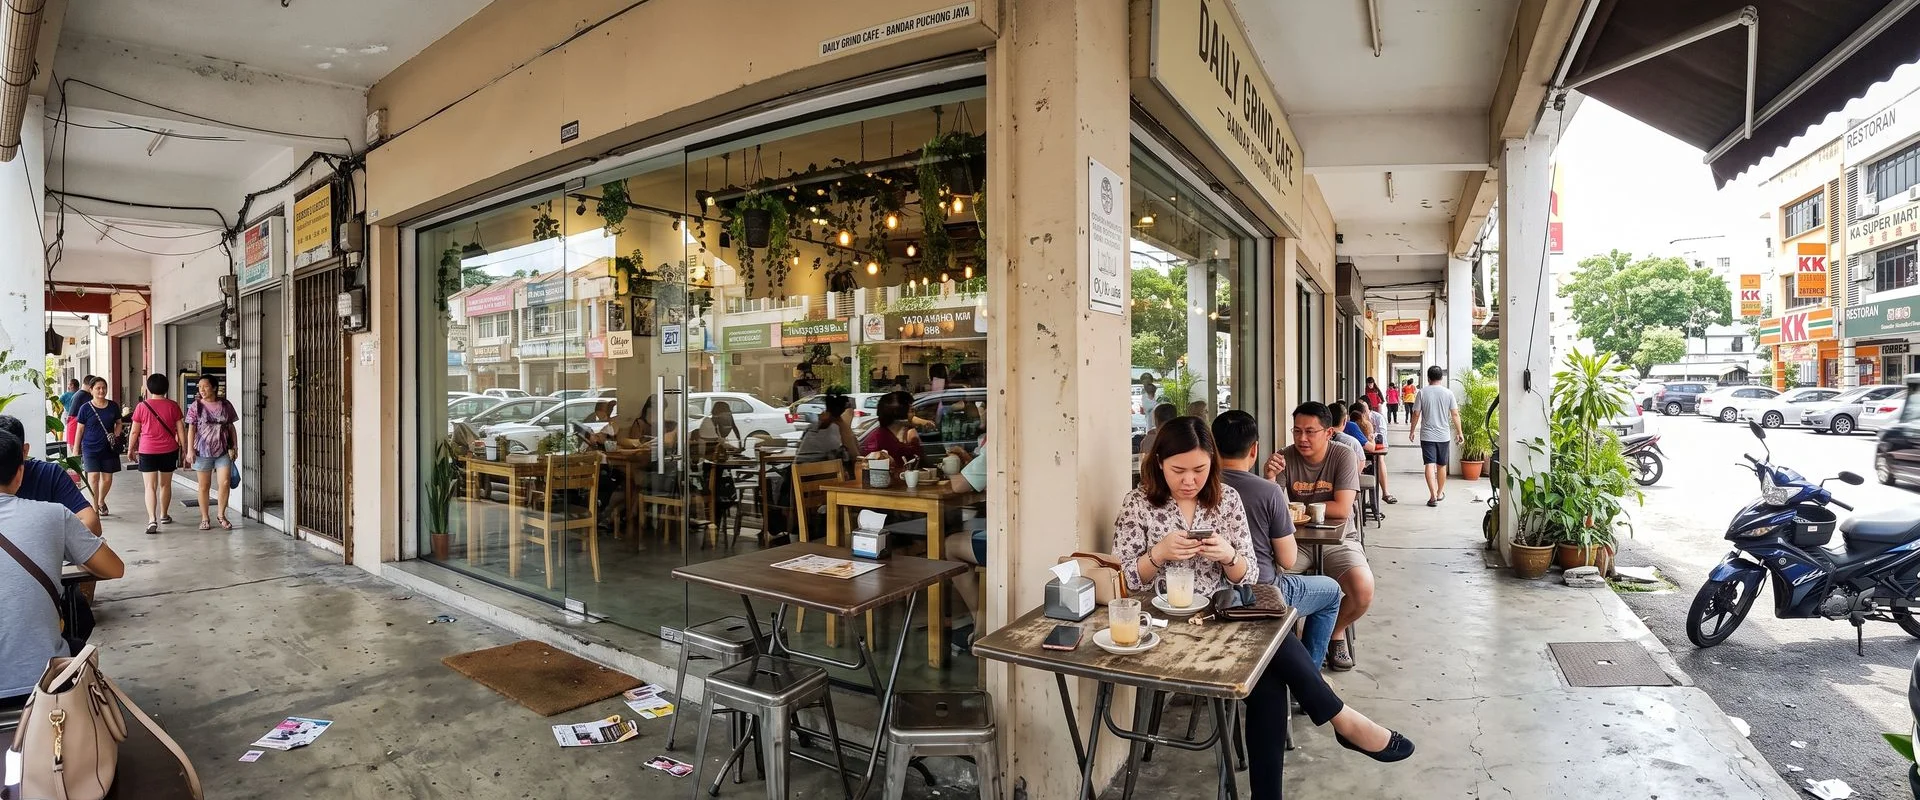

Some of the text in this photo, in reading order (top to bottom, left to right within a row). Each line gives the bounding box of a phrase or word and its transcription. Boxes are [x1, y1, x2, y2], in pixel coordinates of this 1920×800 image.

[822, 40, 841, 54] DAILY
[841, 34, 862, 49] GRIND
[862, 27, 880, 43] CAFE
[886, 19, 914, 36] BANDAR
[916, 10, 951, 29] PUCHONG
[952, 6, 970, 20] JAYA
[1198, 0, 1240, 106] DAILY
[1243, 74, 1274, 155] GRIND
[1275, 127, 1294, 187] CAFE
[1846, 108, 1896, 150] RESTORAN
[1226, 111, 1281, 196] BANDAR PUCHONG JAYA
[1850, 226, 1861, 240] KA
[1863, 216, 1891, 236] SUPER
[1893, 205, 1919, 226] MART
[1798, 256, 1826, 272] KK
[1741, 290, 1761, 301] KK
[1846, 304, 1879, 320] RESTORAN
[1781, 312, 1808, 343] KK
